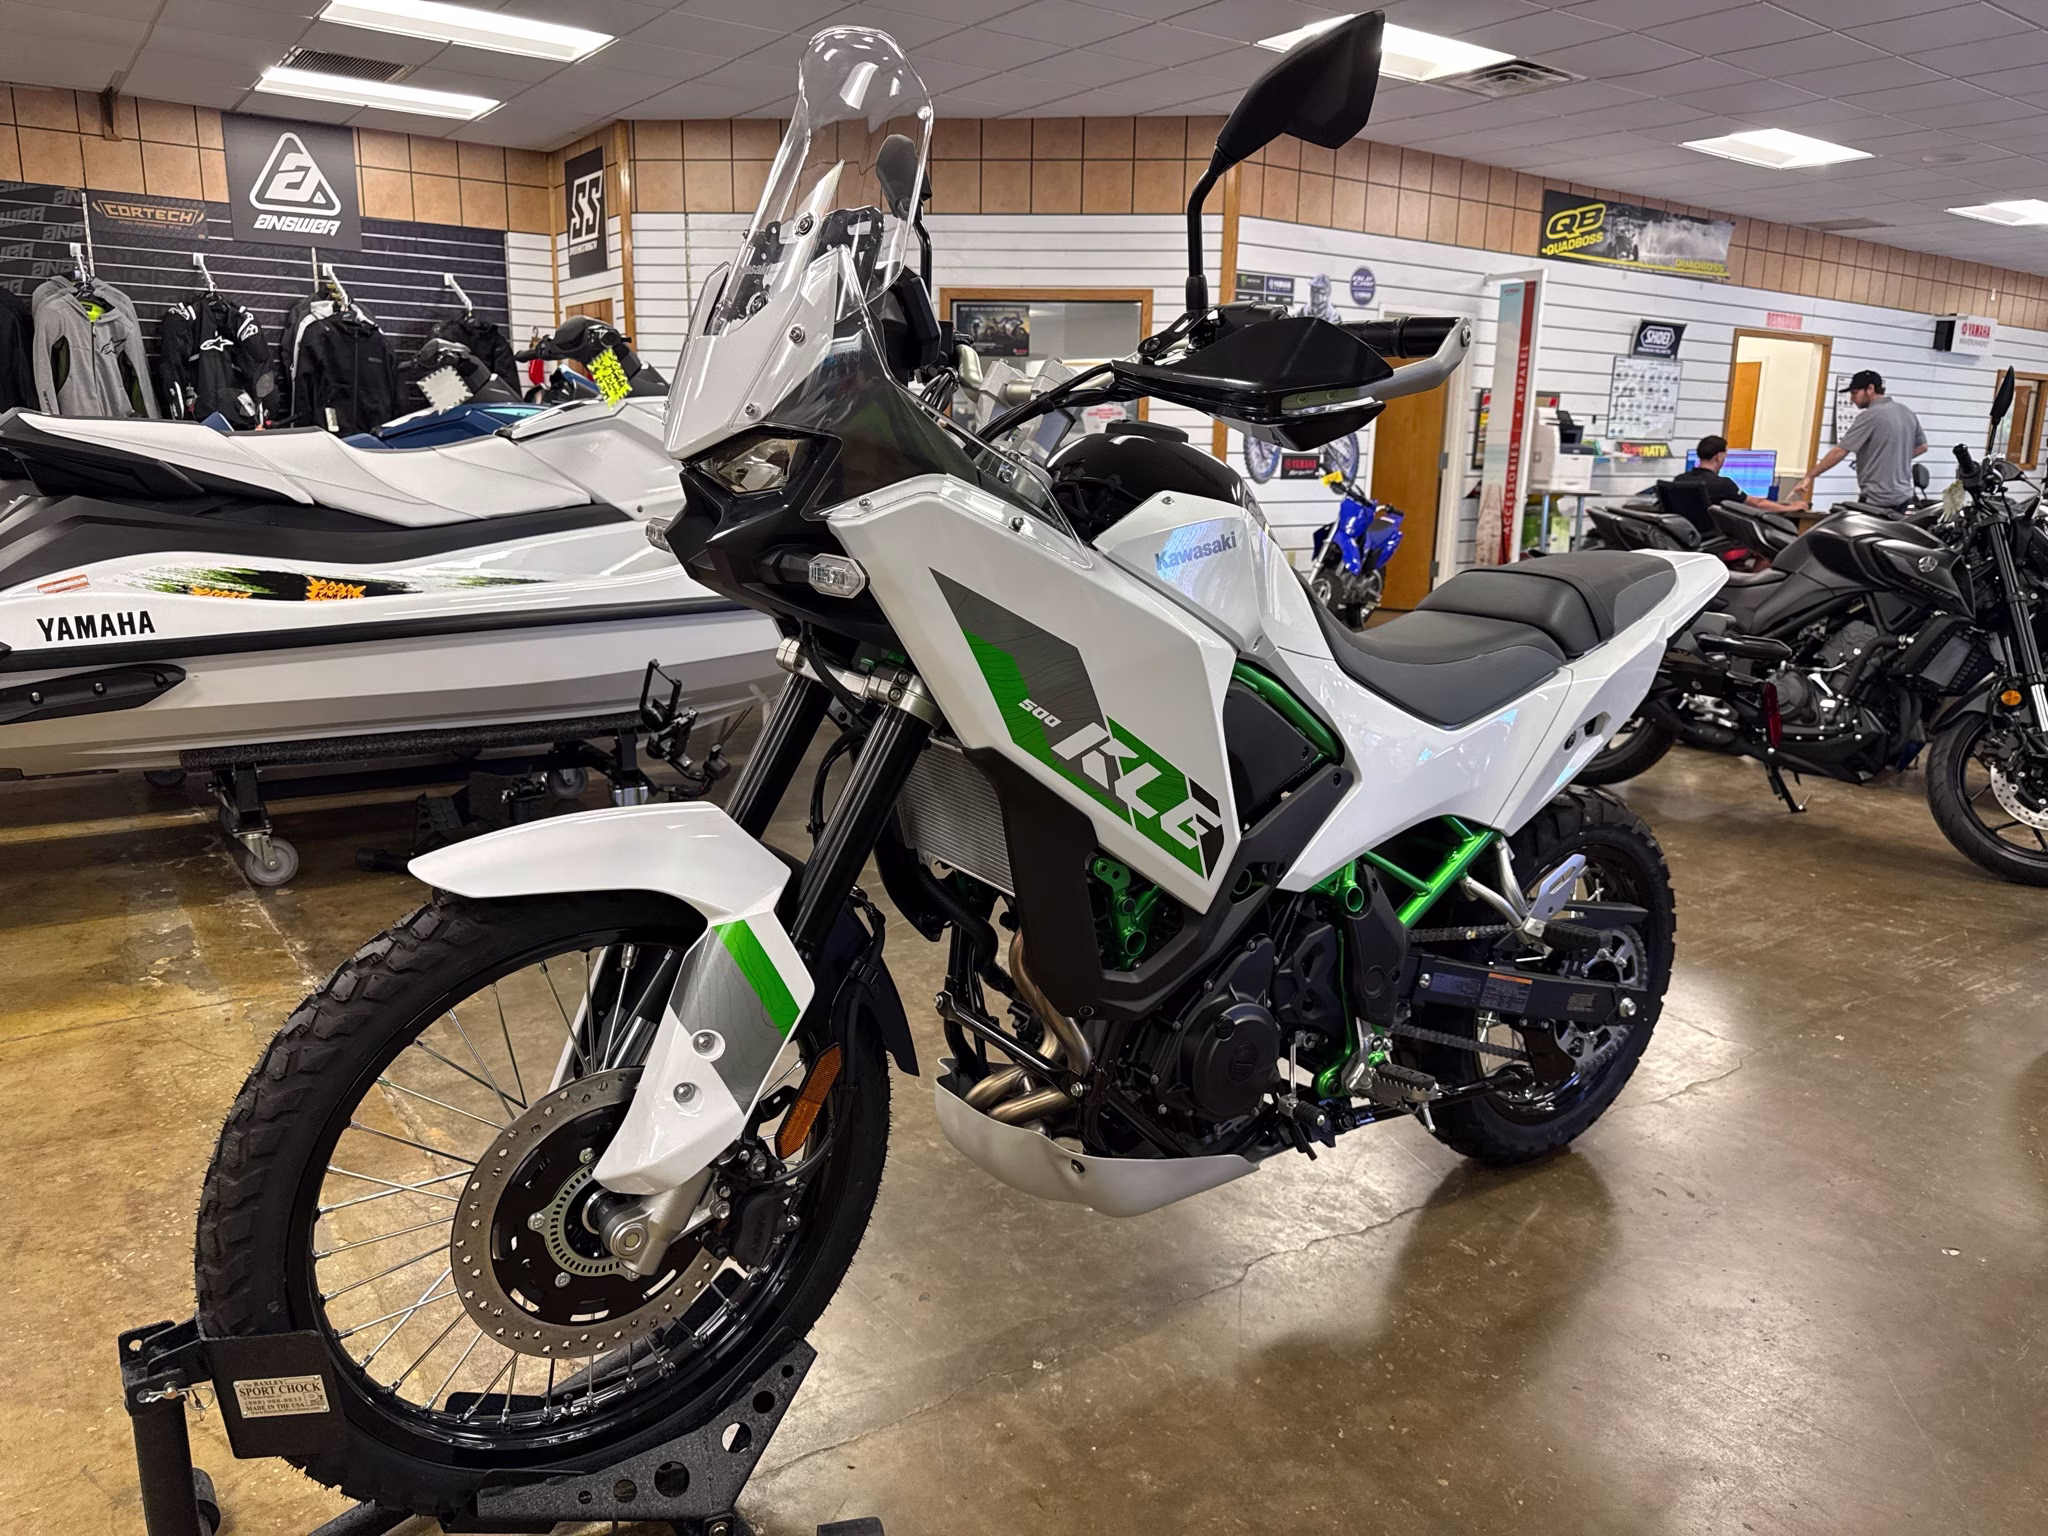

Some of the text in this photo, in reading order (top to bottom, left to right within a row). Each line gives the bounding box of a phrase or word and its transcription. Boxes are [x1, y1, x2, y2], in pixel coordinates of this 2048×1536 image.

[104, 202, 194, 224] CORTECH
[253, 213, 341, 237] ANSWER
[1546, 203, 1606, 239] QB
[1546, 231, 1604, 256] QUADBOSS
[1675, 258, 1725, 273] QUADBOSS
[1645, 329, 1671, 345] SHOEI
[1503, 441, 1520, 535] ACCESSORIES
[1517, 345, 1529, 402] APPAREL
[1154, 531, 1237, 571] Kawasaki
[36, 611, 156, 642] YAMAHA
[1018, 699, 1062, 728] 500
[1051, 722, 1223, 850] KLE
[239, 1385, 276, 1398] SPORT
[278, 1382, 321, 1395] CHOCK
[253, 1379, 285, 1388] BAXLEY
